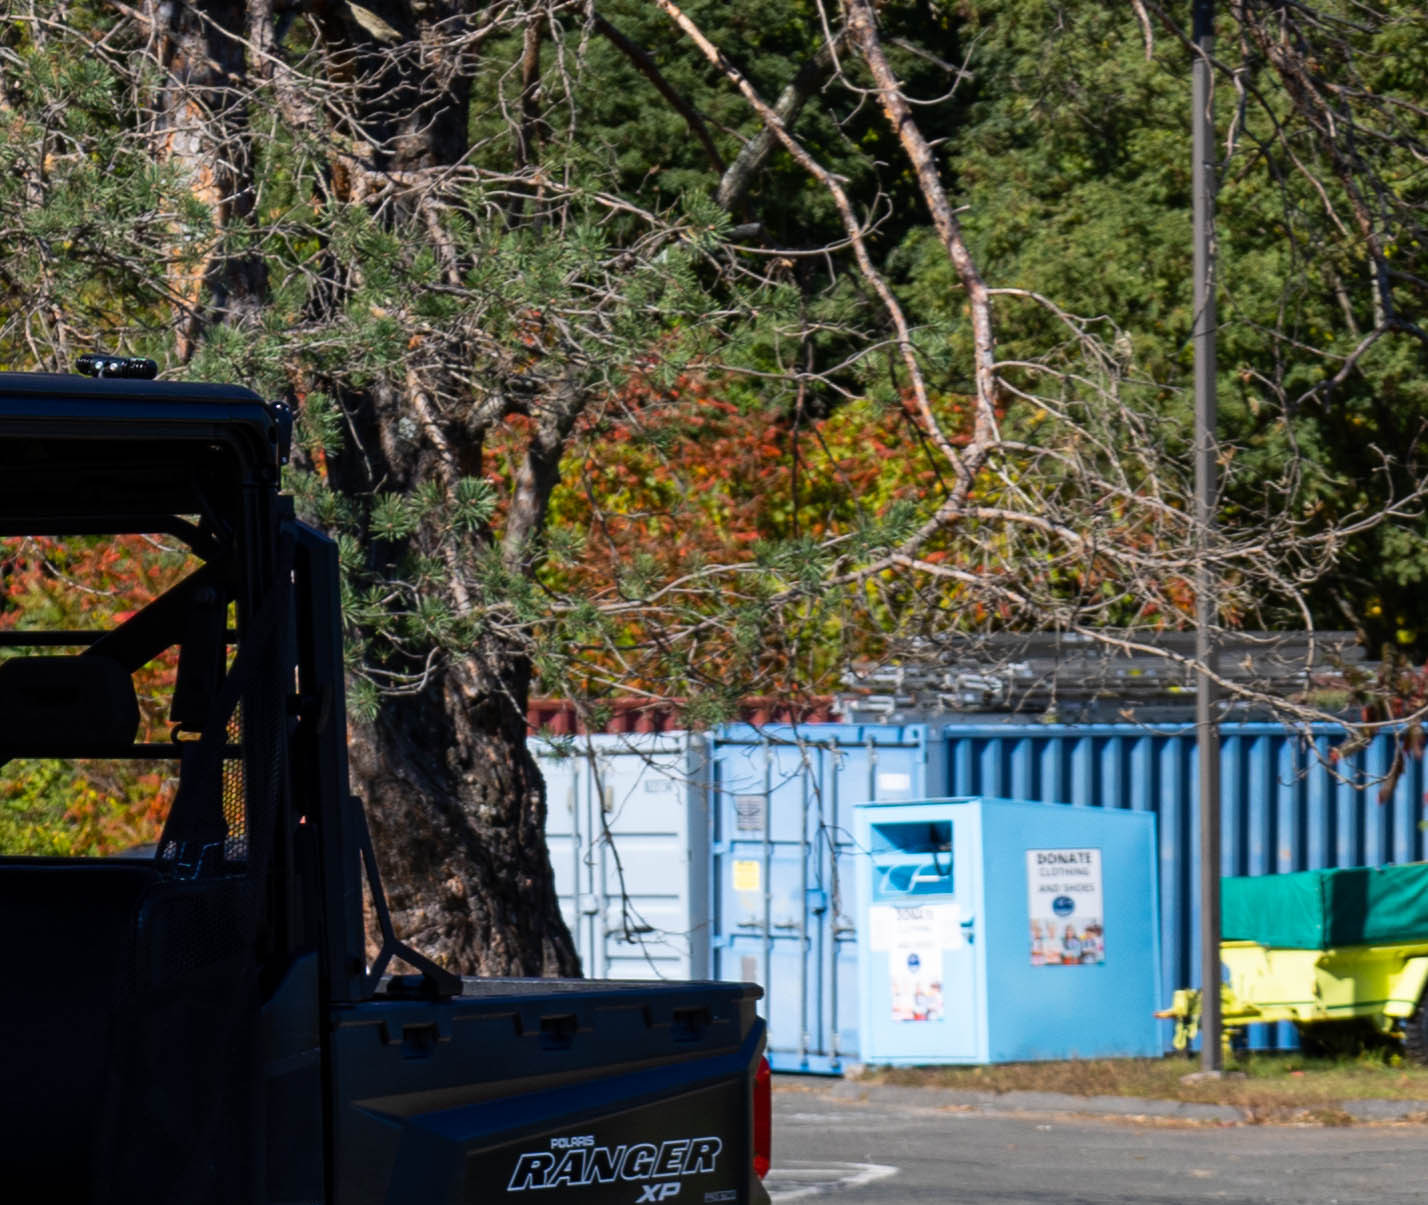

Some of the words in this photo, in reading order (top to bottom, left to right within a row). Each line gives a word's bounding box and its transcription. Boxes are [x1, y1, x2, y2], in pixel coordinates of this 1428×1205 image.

[1037, 852, 1092, 865] DONATE
[550, 1135, 595, 1150] POLARIS
[507, 1136, 723, 1191] RANGER
[635, 1182, 681, 1203] XP
